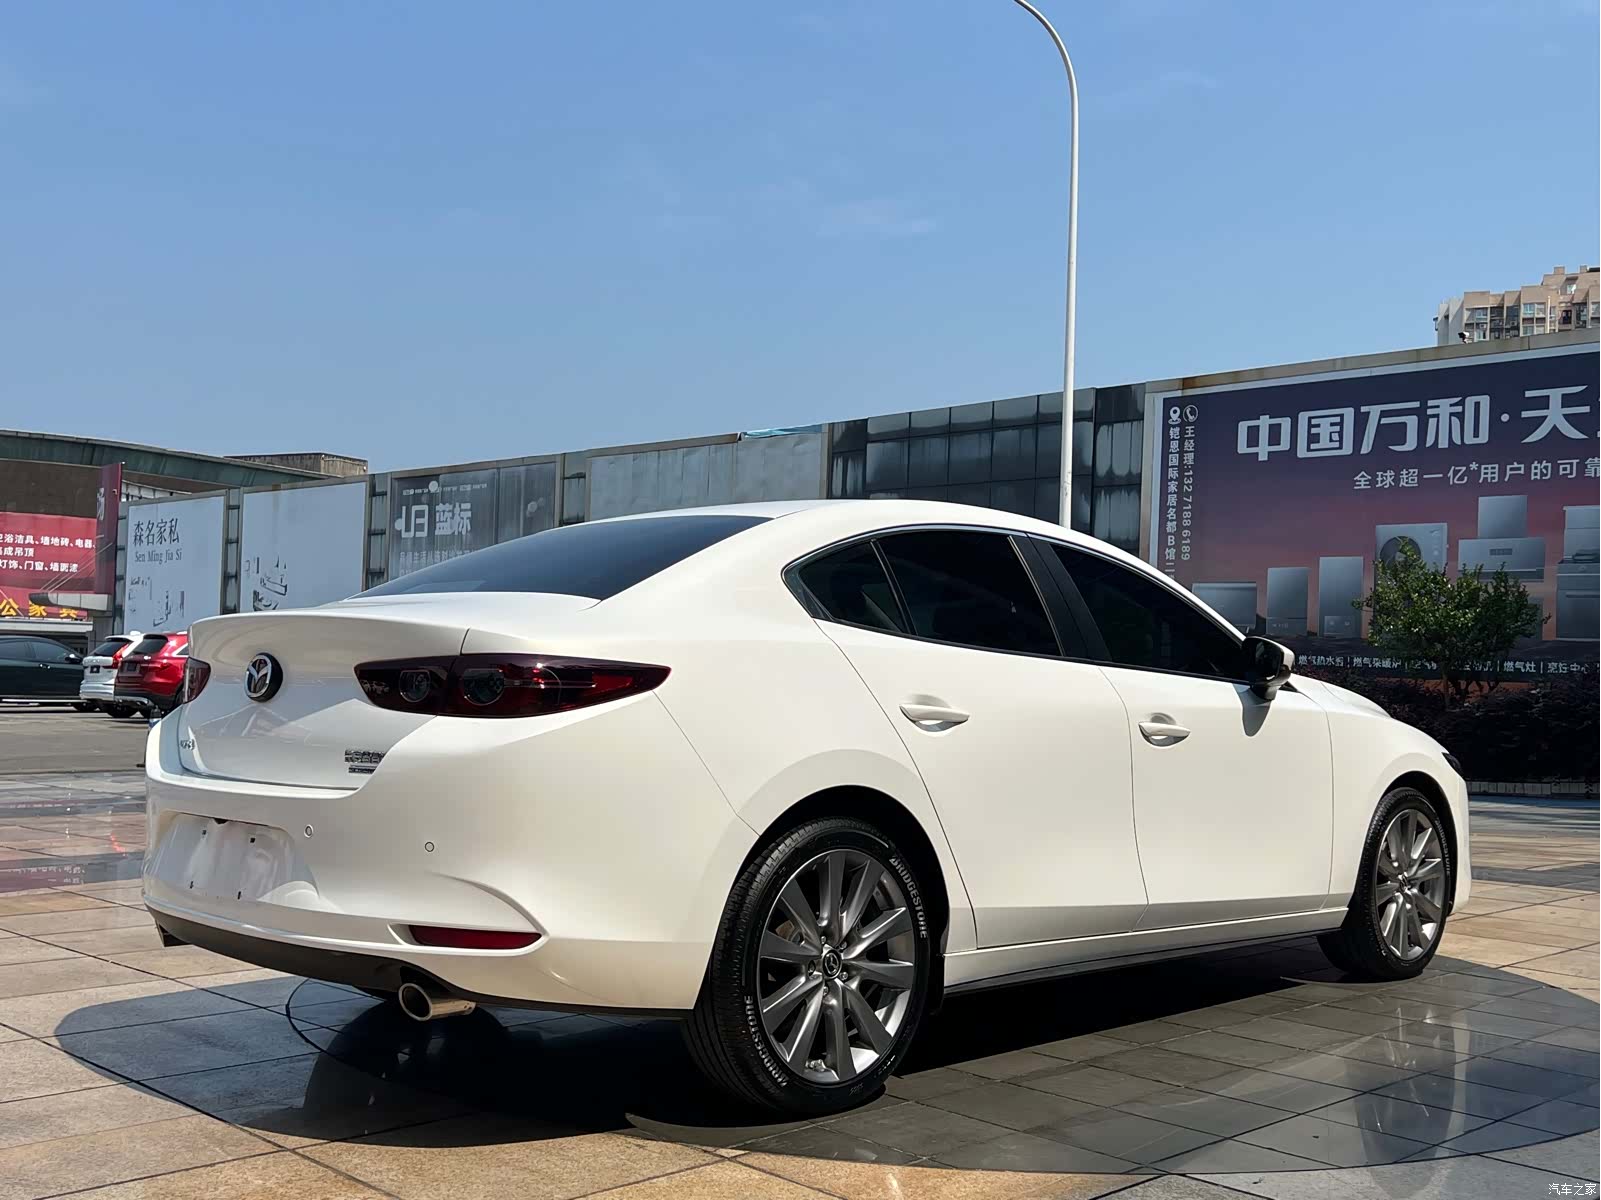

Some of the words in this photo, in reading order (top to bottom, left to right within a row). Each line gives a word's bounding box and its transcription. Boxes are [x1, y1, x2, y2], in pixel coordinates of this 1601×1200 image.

[1237, 385, 1600, 461] 中国万和·天
[133, 517, 180, 547] 森名家私
[435, 502, 470, 536] 蓝标
[0, 546, 35, 557] 成吊顶
[134, 551, 146, 562] Sen
[147, 549, 163, 565] Ming
[888, 854, 928, 939] BRIDGESTONE
